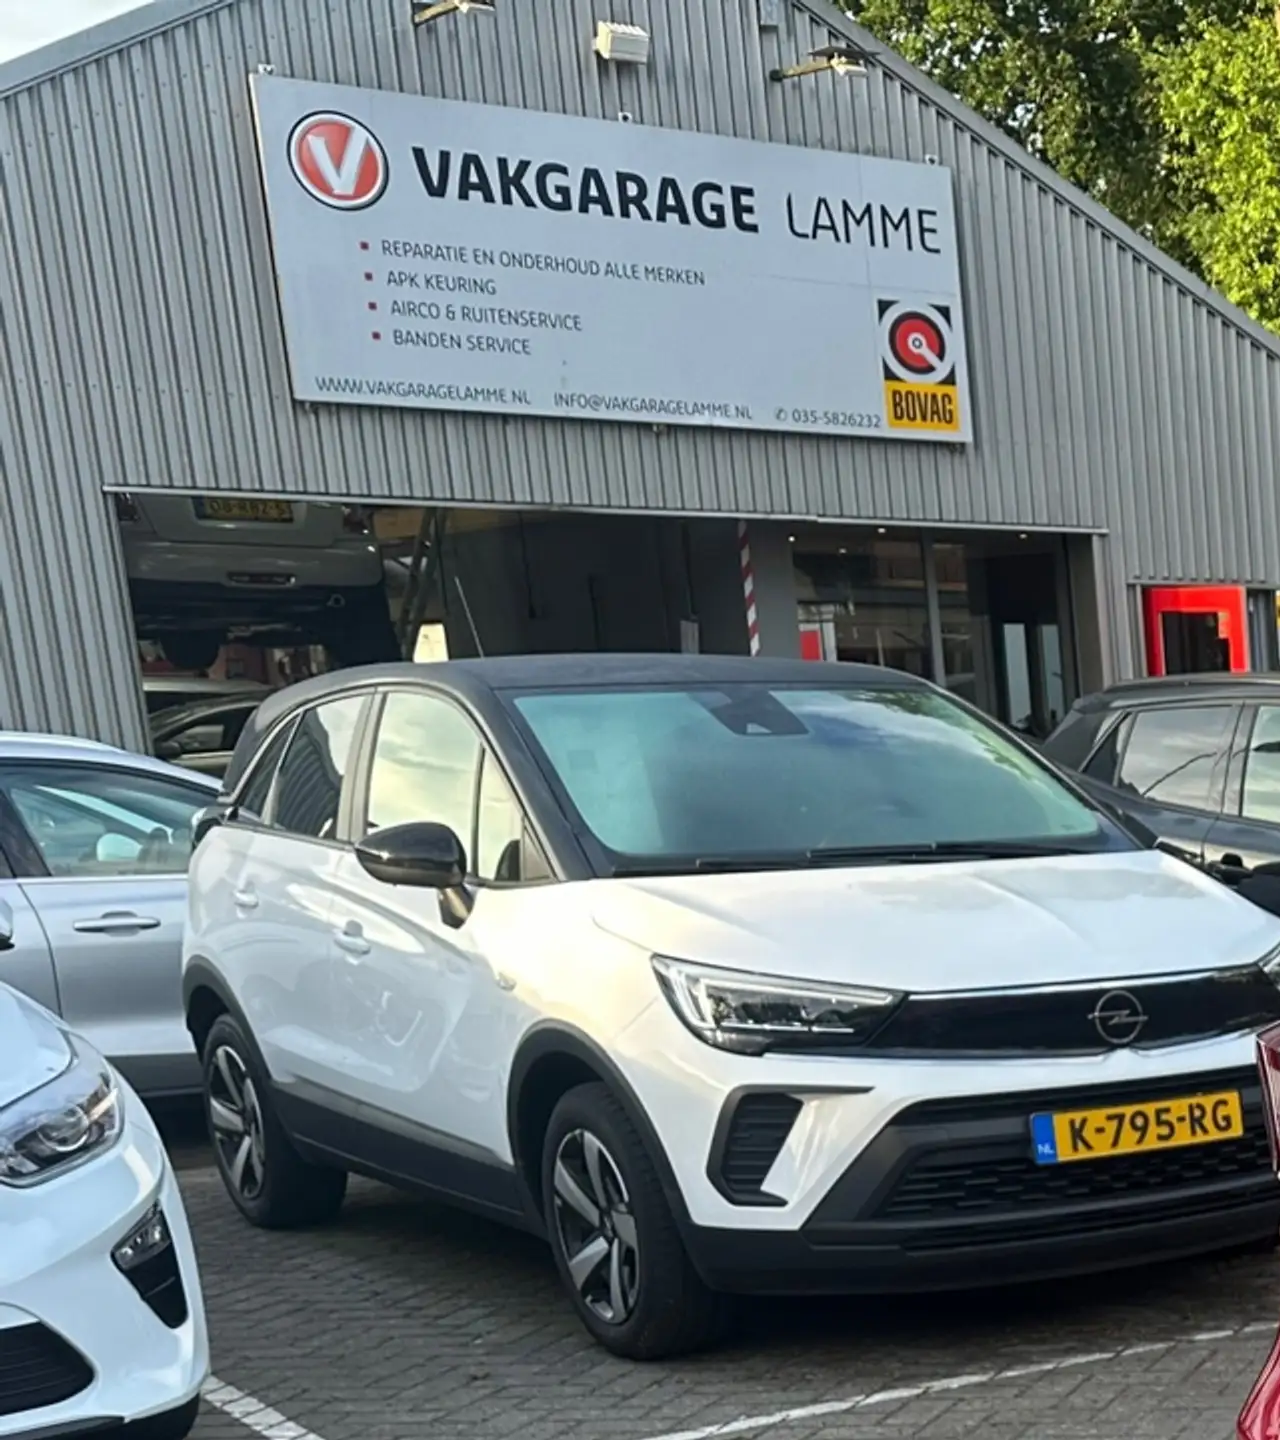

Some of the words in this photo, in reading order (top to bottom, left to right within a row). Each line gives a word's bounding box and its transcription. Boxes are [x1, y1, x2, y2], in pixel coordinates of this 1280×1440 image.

[412, 146, 760, 234] VAKGARAGE
[786, 192, 942, 254] LAMME
[382, 240, 467, 264] REPARATIE
[473, 248, 494, 266] EN
[500, 251, 600, 277] ONDERHOUD
[604, 261, 640, 280] ALLE
[645, 266, 705, 286] MERKEN
[387, 270, 420, 288] APK
[425, 273, 497, 296] KEURING
[391, 300, 440, 321] AIRCO
[462, 305, 583, 331] RUITENSERVICE
[393, 329, 461, 351] BANDEN
[467, 335, 531, 355] SERVICE
[315, 376, 532, 406] WWW.VAKGARAGELAMME.NL
[554, 392, 752, 420] INFO@VAKGARAGELAMME.NL
[792, 409, 882, 429] 035-5826232
[891, 389, 954, 424] BOVAG
[1068, 1098, 1233, 1154] K-795-RG
[1037, 1143, 1055, 1155] NL
